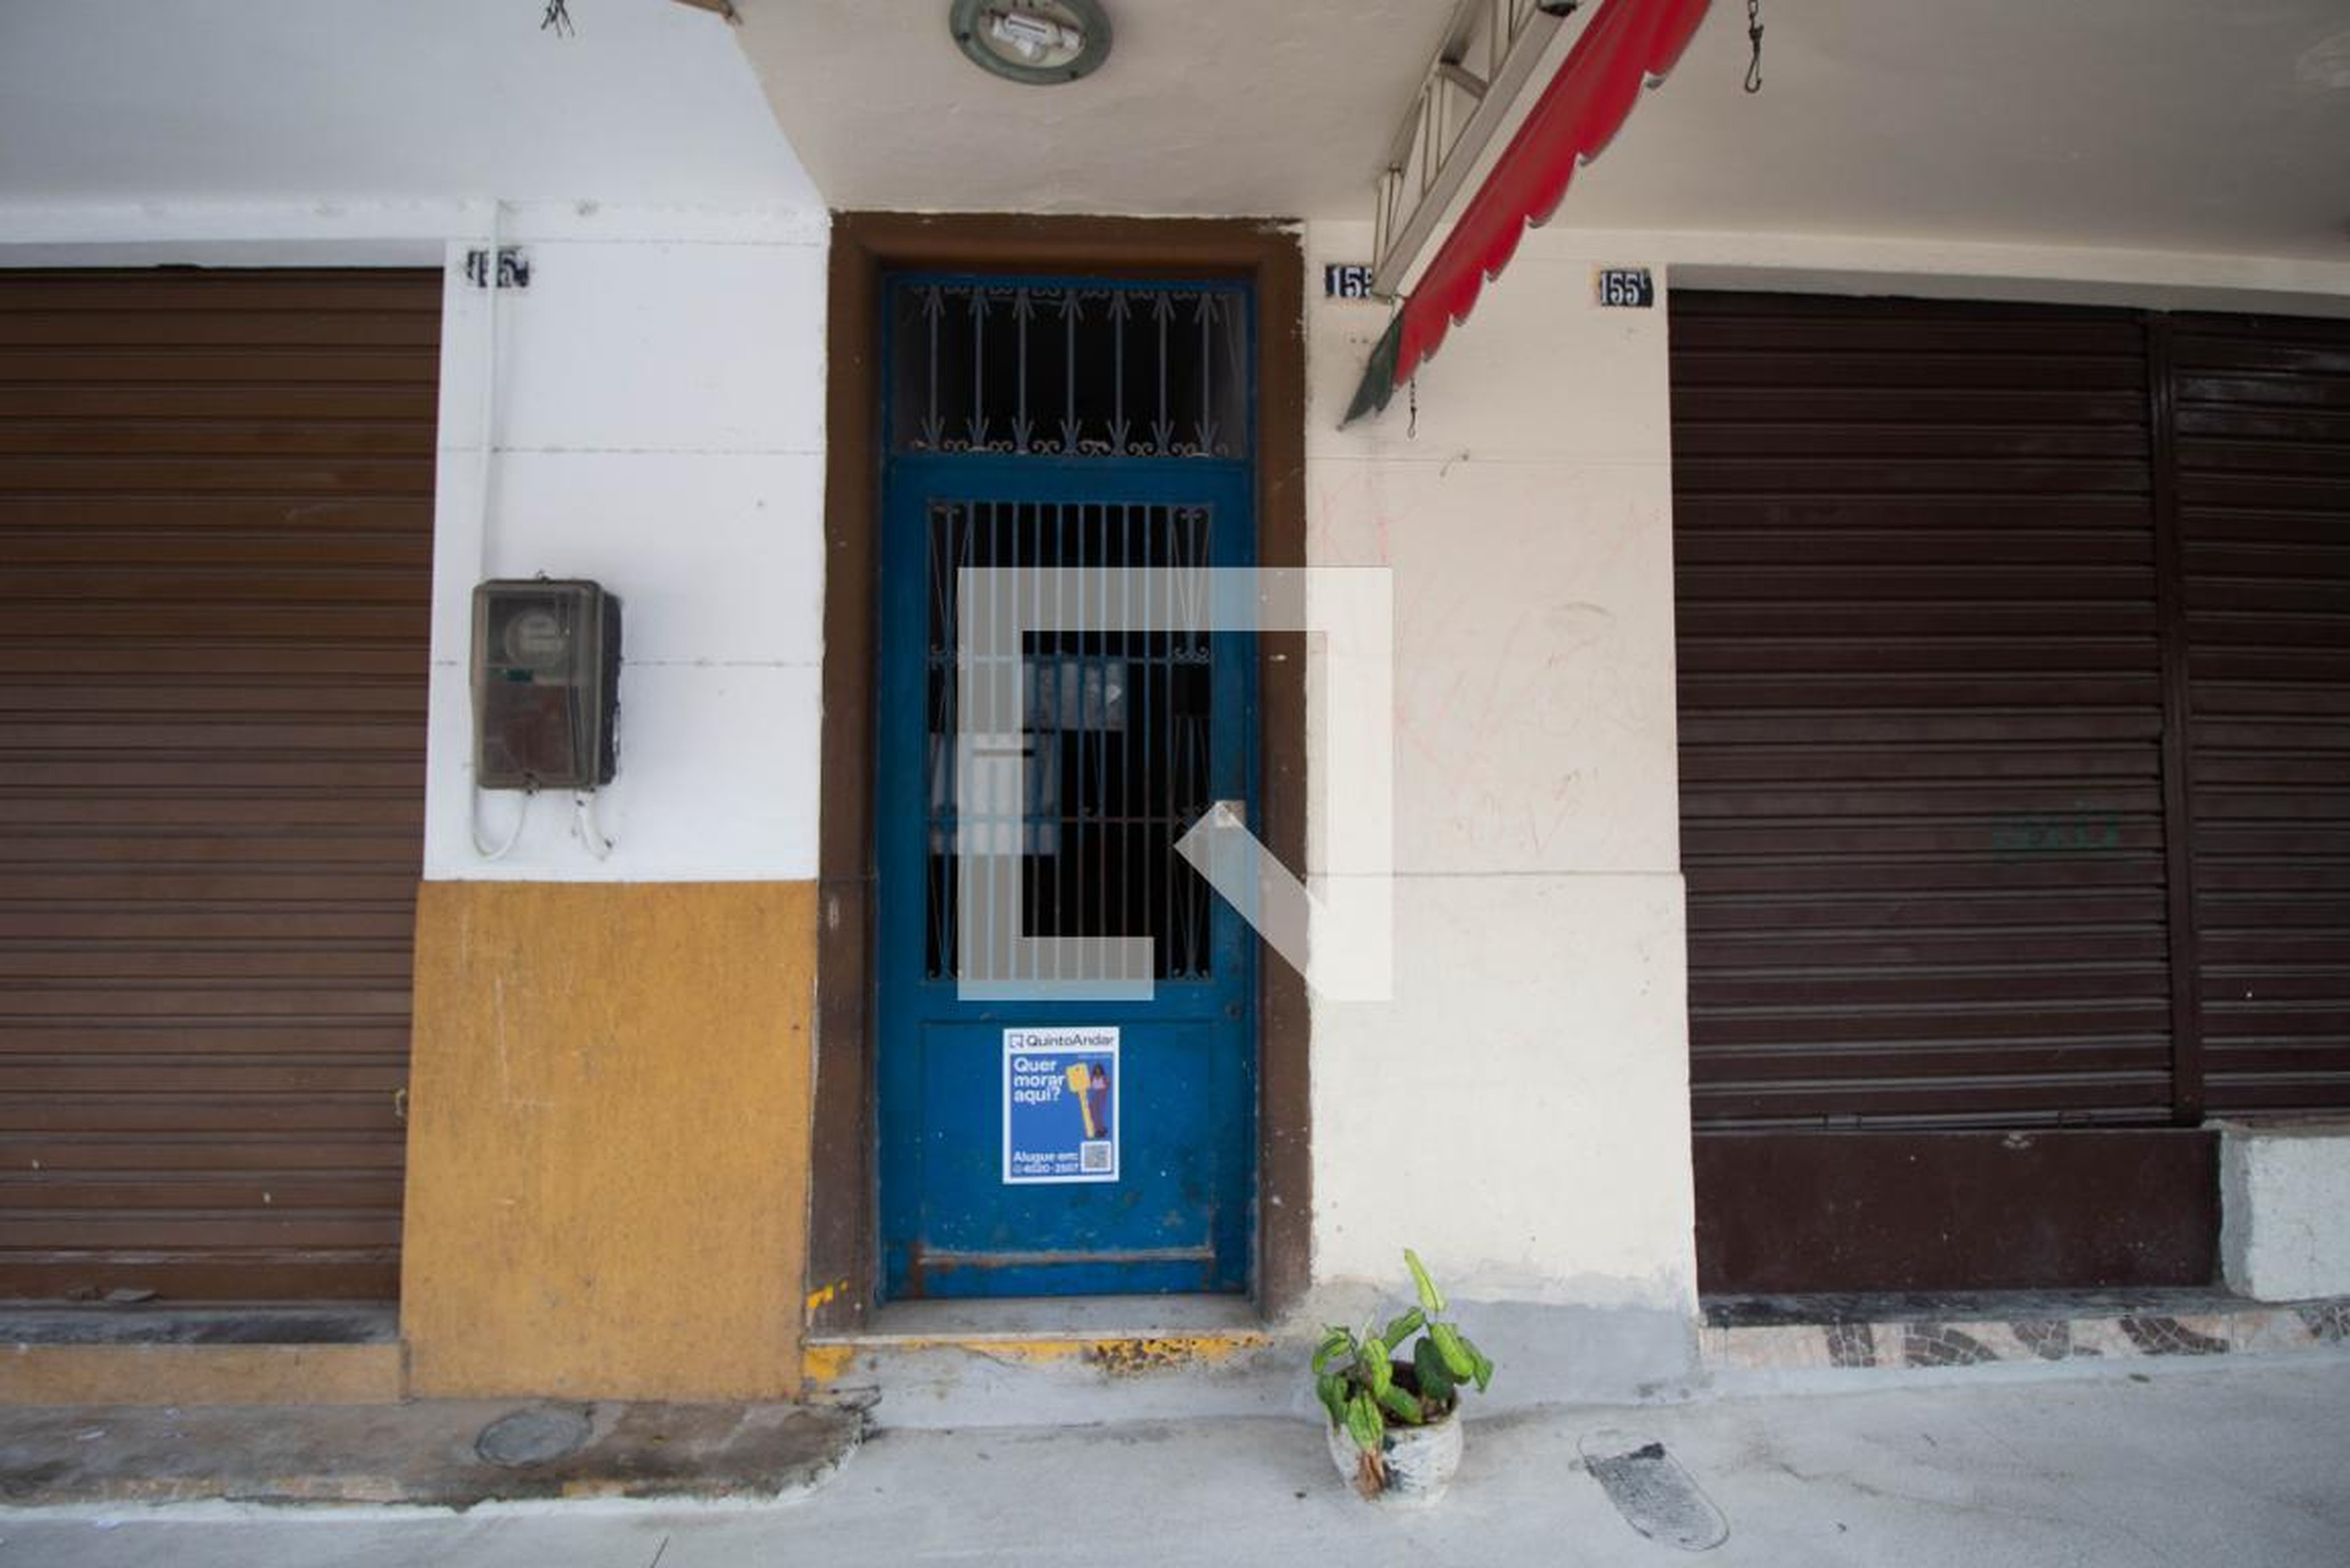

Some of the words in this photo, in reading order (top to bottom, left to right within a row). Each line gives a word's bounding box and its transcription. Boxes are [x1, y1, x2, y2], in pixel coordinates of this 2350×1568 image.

[1026, 1034, 1114, 1047] QuintoAndar
[1013, 1057, 1056, 1073] Quer
[1013, 1075, 1065, 1088] morar
[1013, 1086, 1061, 1105] aqui?
